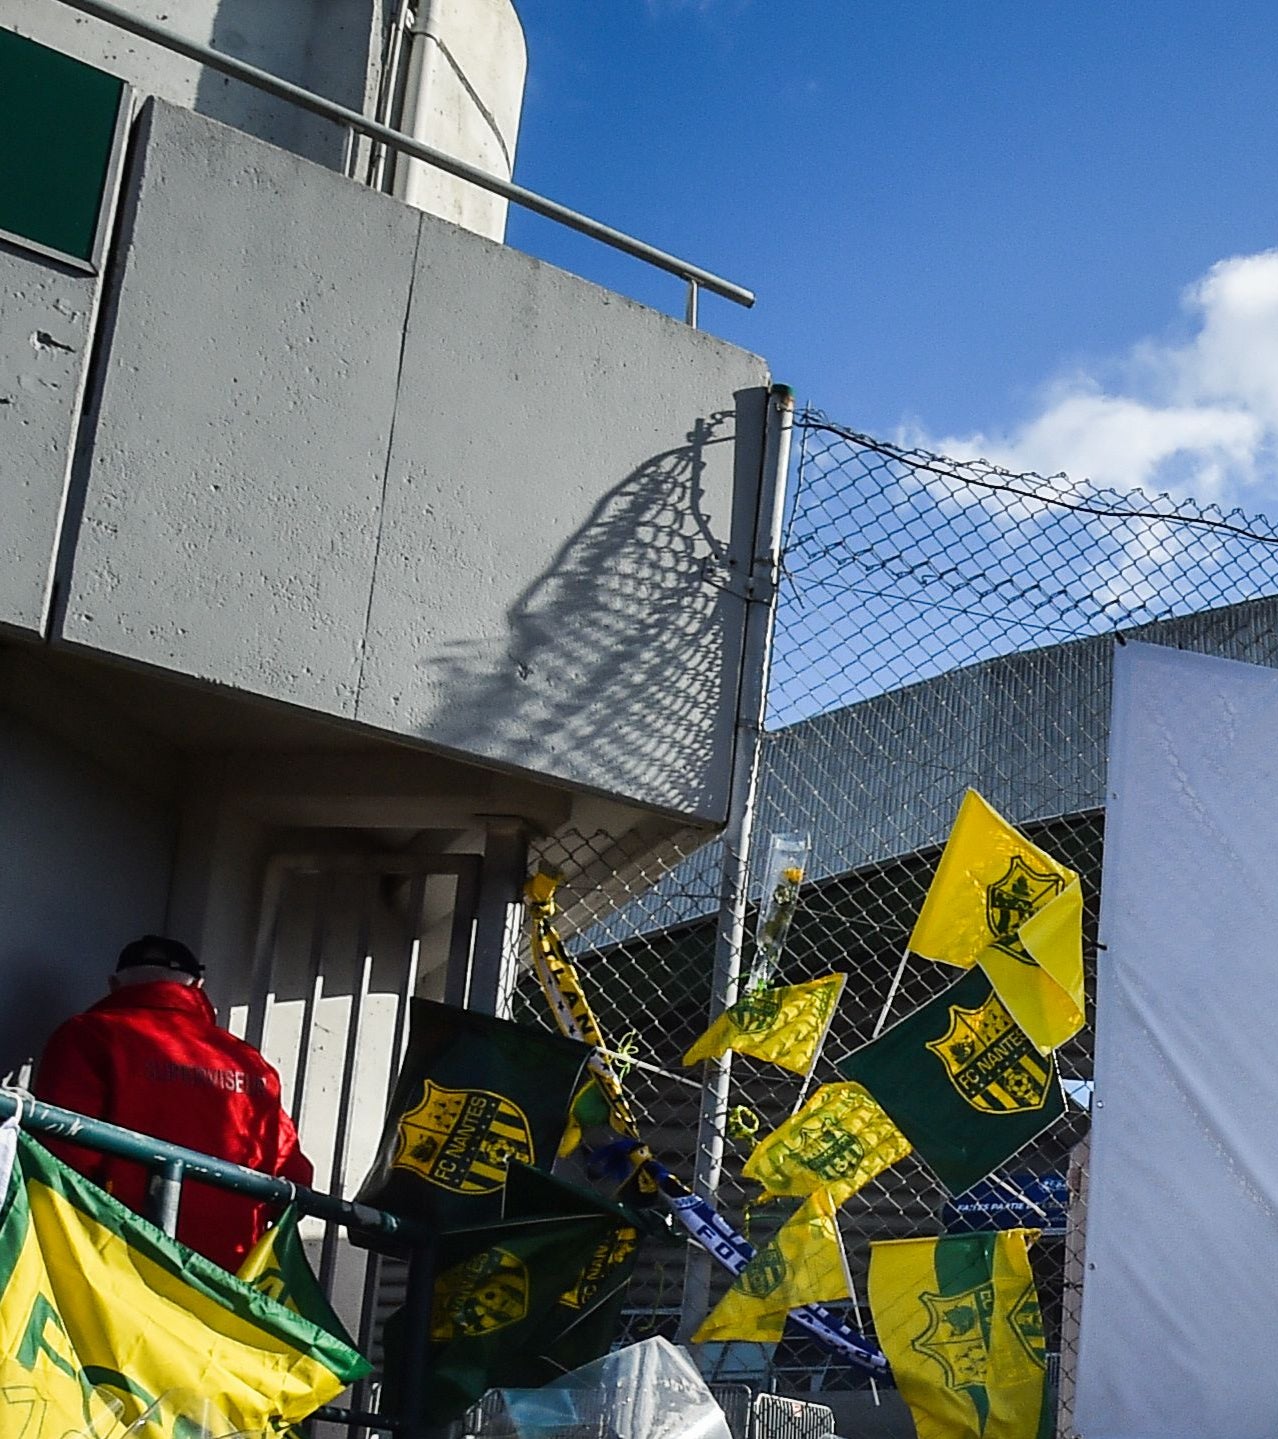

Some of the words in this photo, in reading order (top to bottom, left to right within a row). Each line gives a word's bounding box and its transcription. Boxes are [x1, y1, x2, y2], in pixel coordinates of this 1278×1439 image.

[958, 1069, 980, 1090] FC
[445, 1096, 487, 1159] NANTES
[434, 1160, 457, 1181] FC
